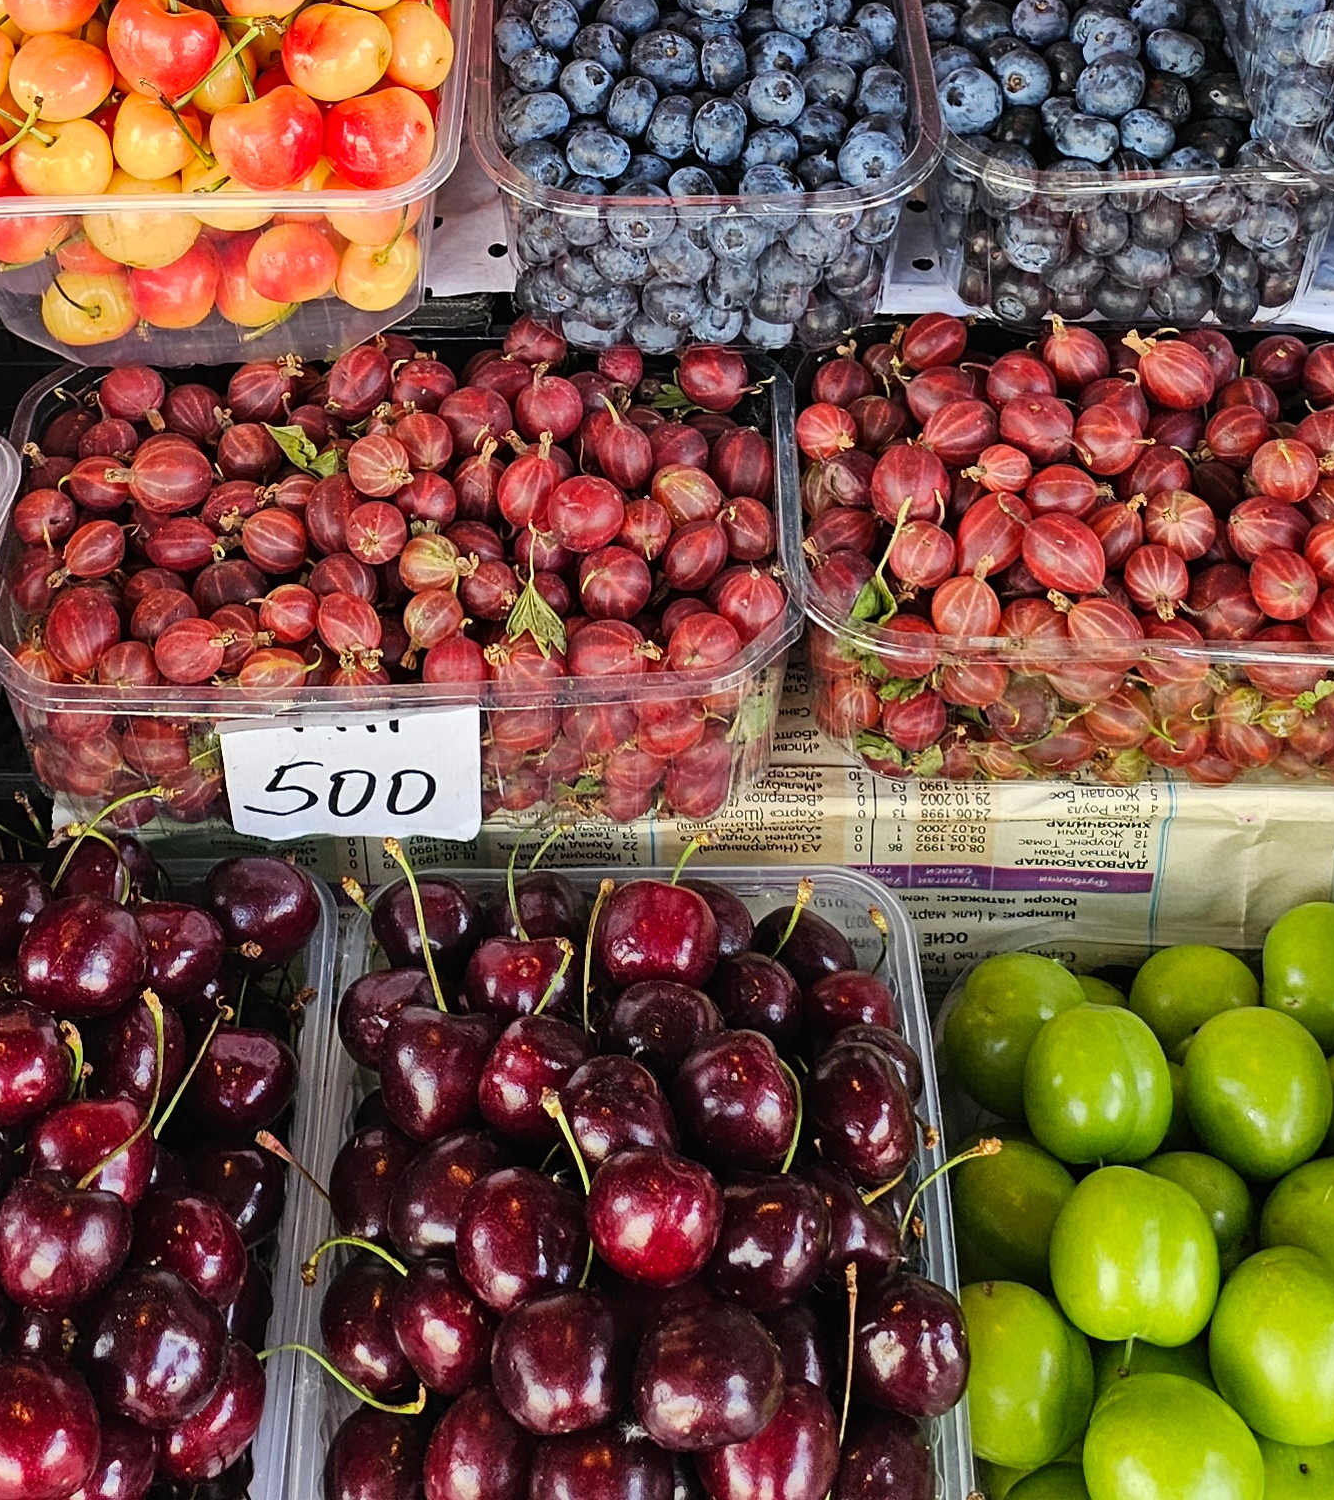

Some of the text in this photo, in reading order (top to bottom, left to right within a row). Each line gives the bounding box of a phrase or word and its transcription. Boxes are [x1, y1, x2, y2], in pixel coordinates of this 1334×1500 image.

[772, 742, 820, 754] «Ипсви
[766, 770, 822, 780] «Лестер
[243, 761, 437, 818] 500
[752, 780, 823, 791] «Мельбур
[899, 794, 907, 805] 6
[920, 792, 991, 806] 29.10.2002
[1150, 788, 1158, 800] 5
[921, 808, 991, 820] 24.06.1998
[916, 824, 986, 834] 04.07.2000
[915, 834, 985, 844] 09.05.1992
[1018, 839, 1059, 848] Томас
[888, 843, 903, 852] 86
[915, 843, 985, 853] 08.04.1992
[1014, 858, 1148, 869] ДАРВОЗАБОНЛАР
[987, 911, 996, 920] 4
